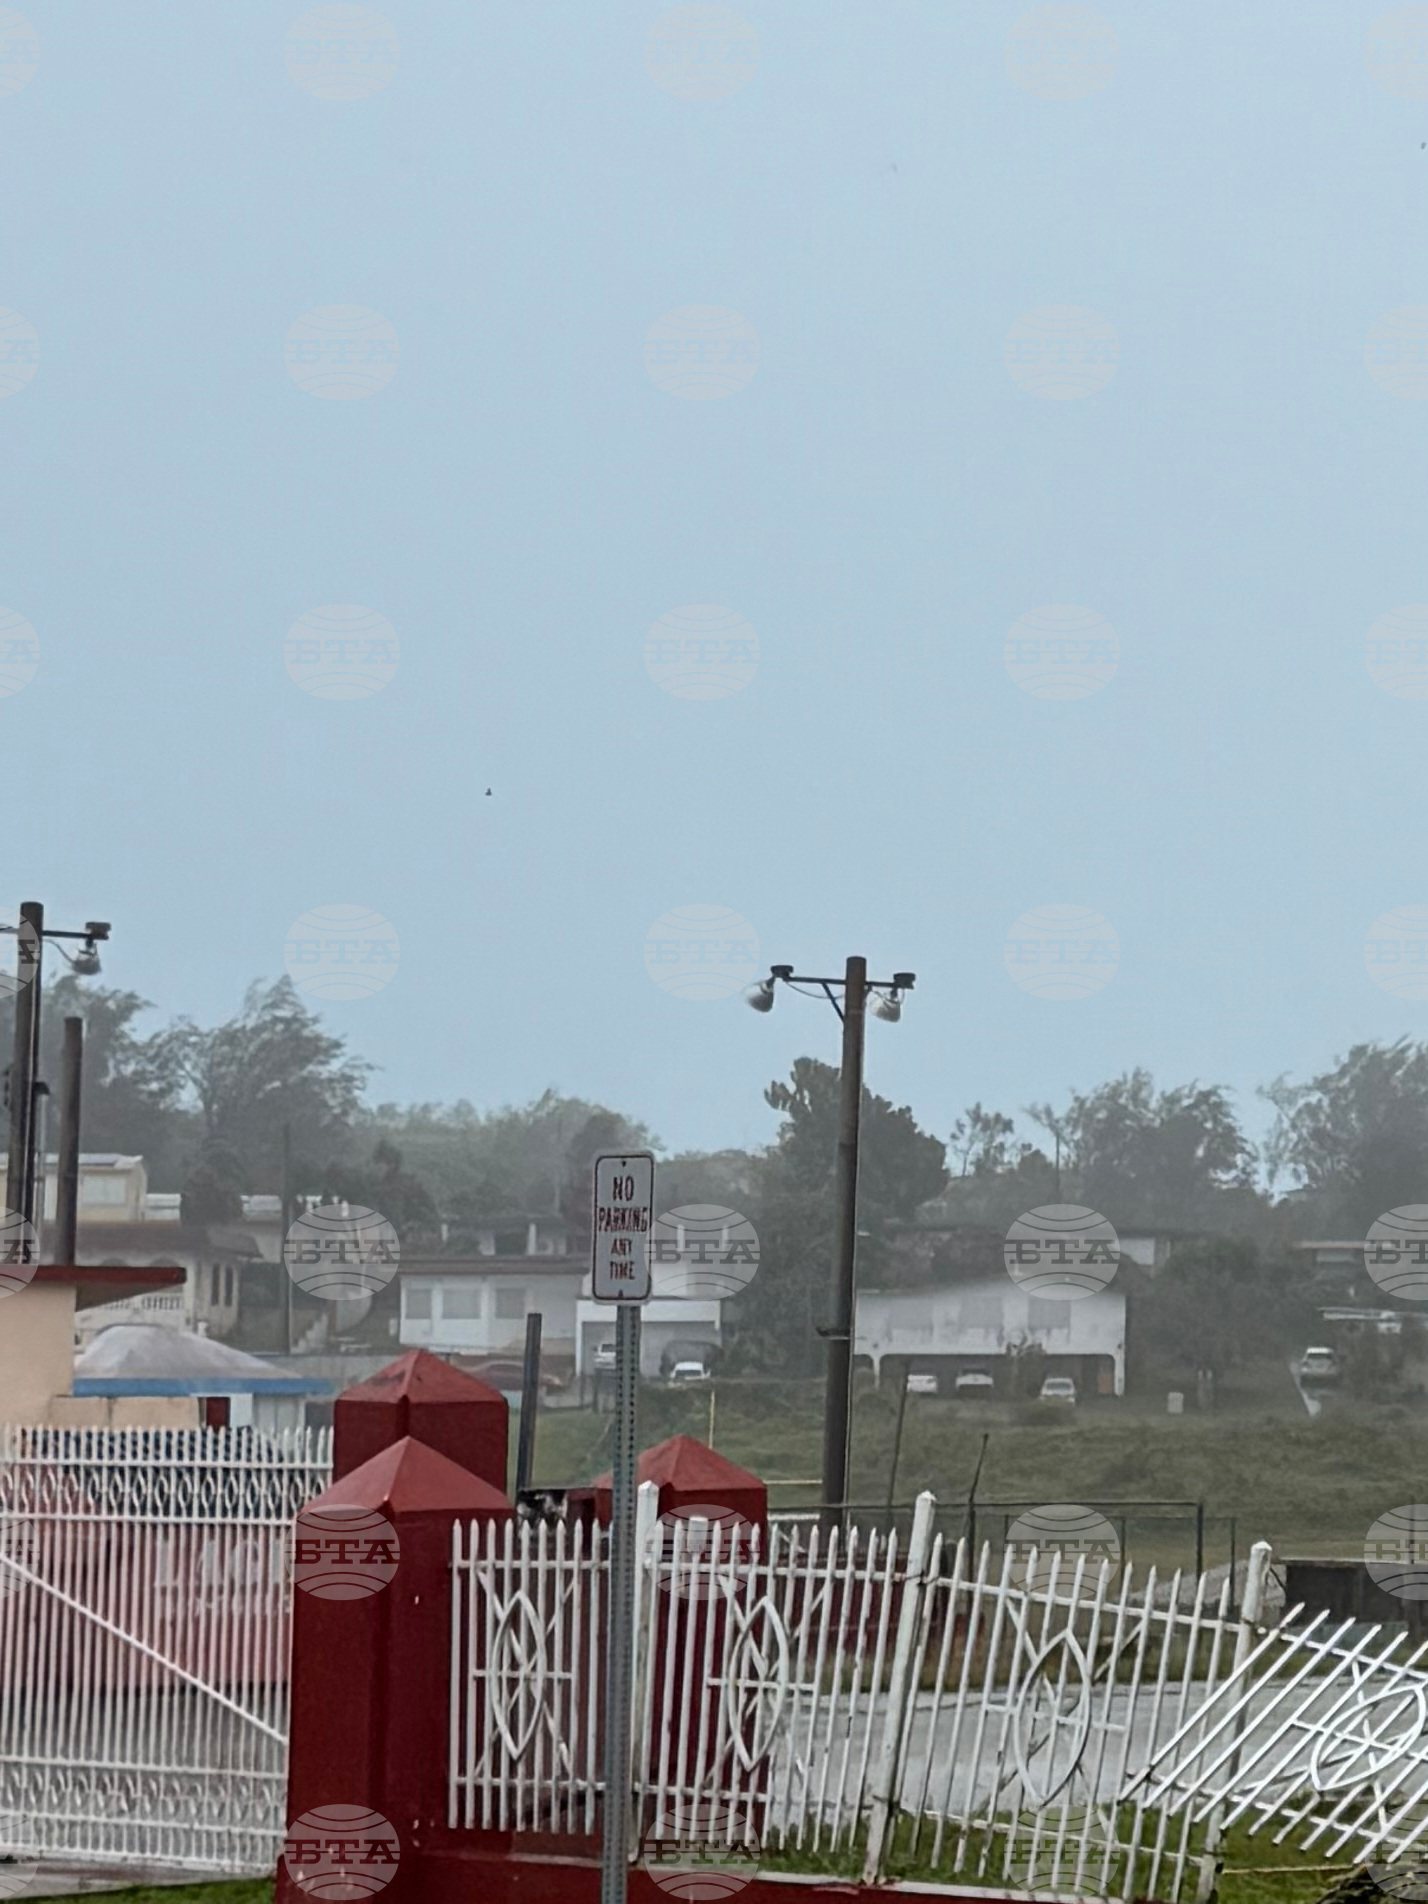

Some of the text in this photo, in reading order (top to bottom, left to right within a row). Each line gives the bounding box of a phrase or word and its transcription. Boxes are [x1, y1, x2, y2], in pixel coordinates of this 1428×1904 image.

[613, 1177, 634, 1201] NO
[599, 1207, 647, 1232] PARKING
[611, 1239, 632, 1256] ANY
[610, 1262, 635, 1280] TIME
